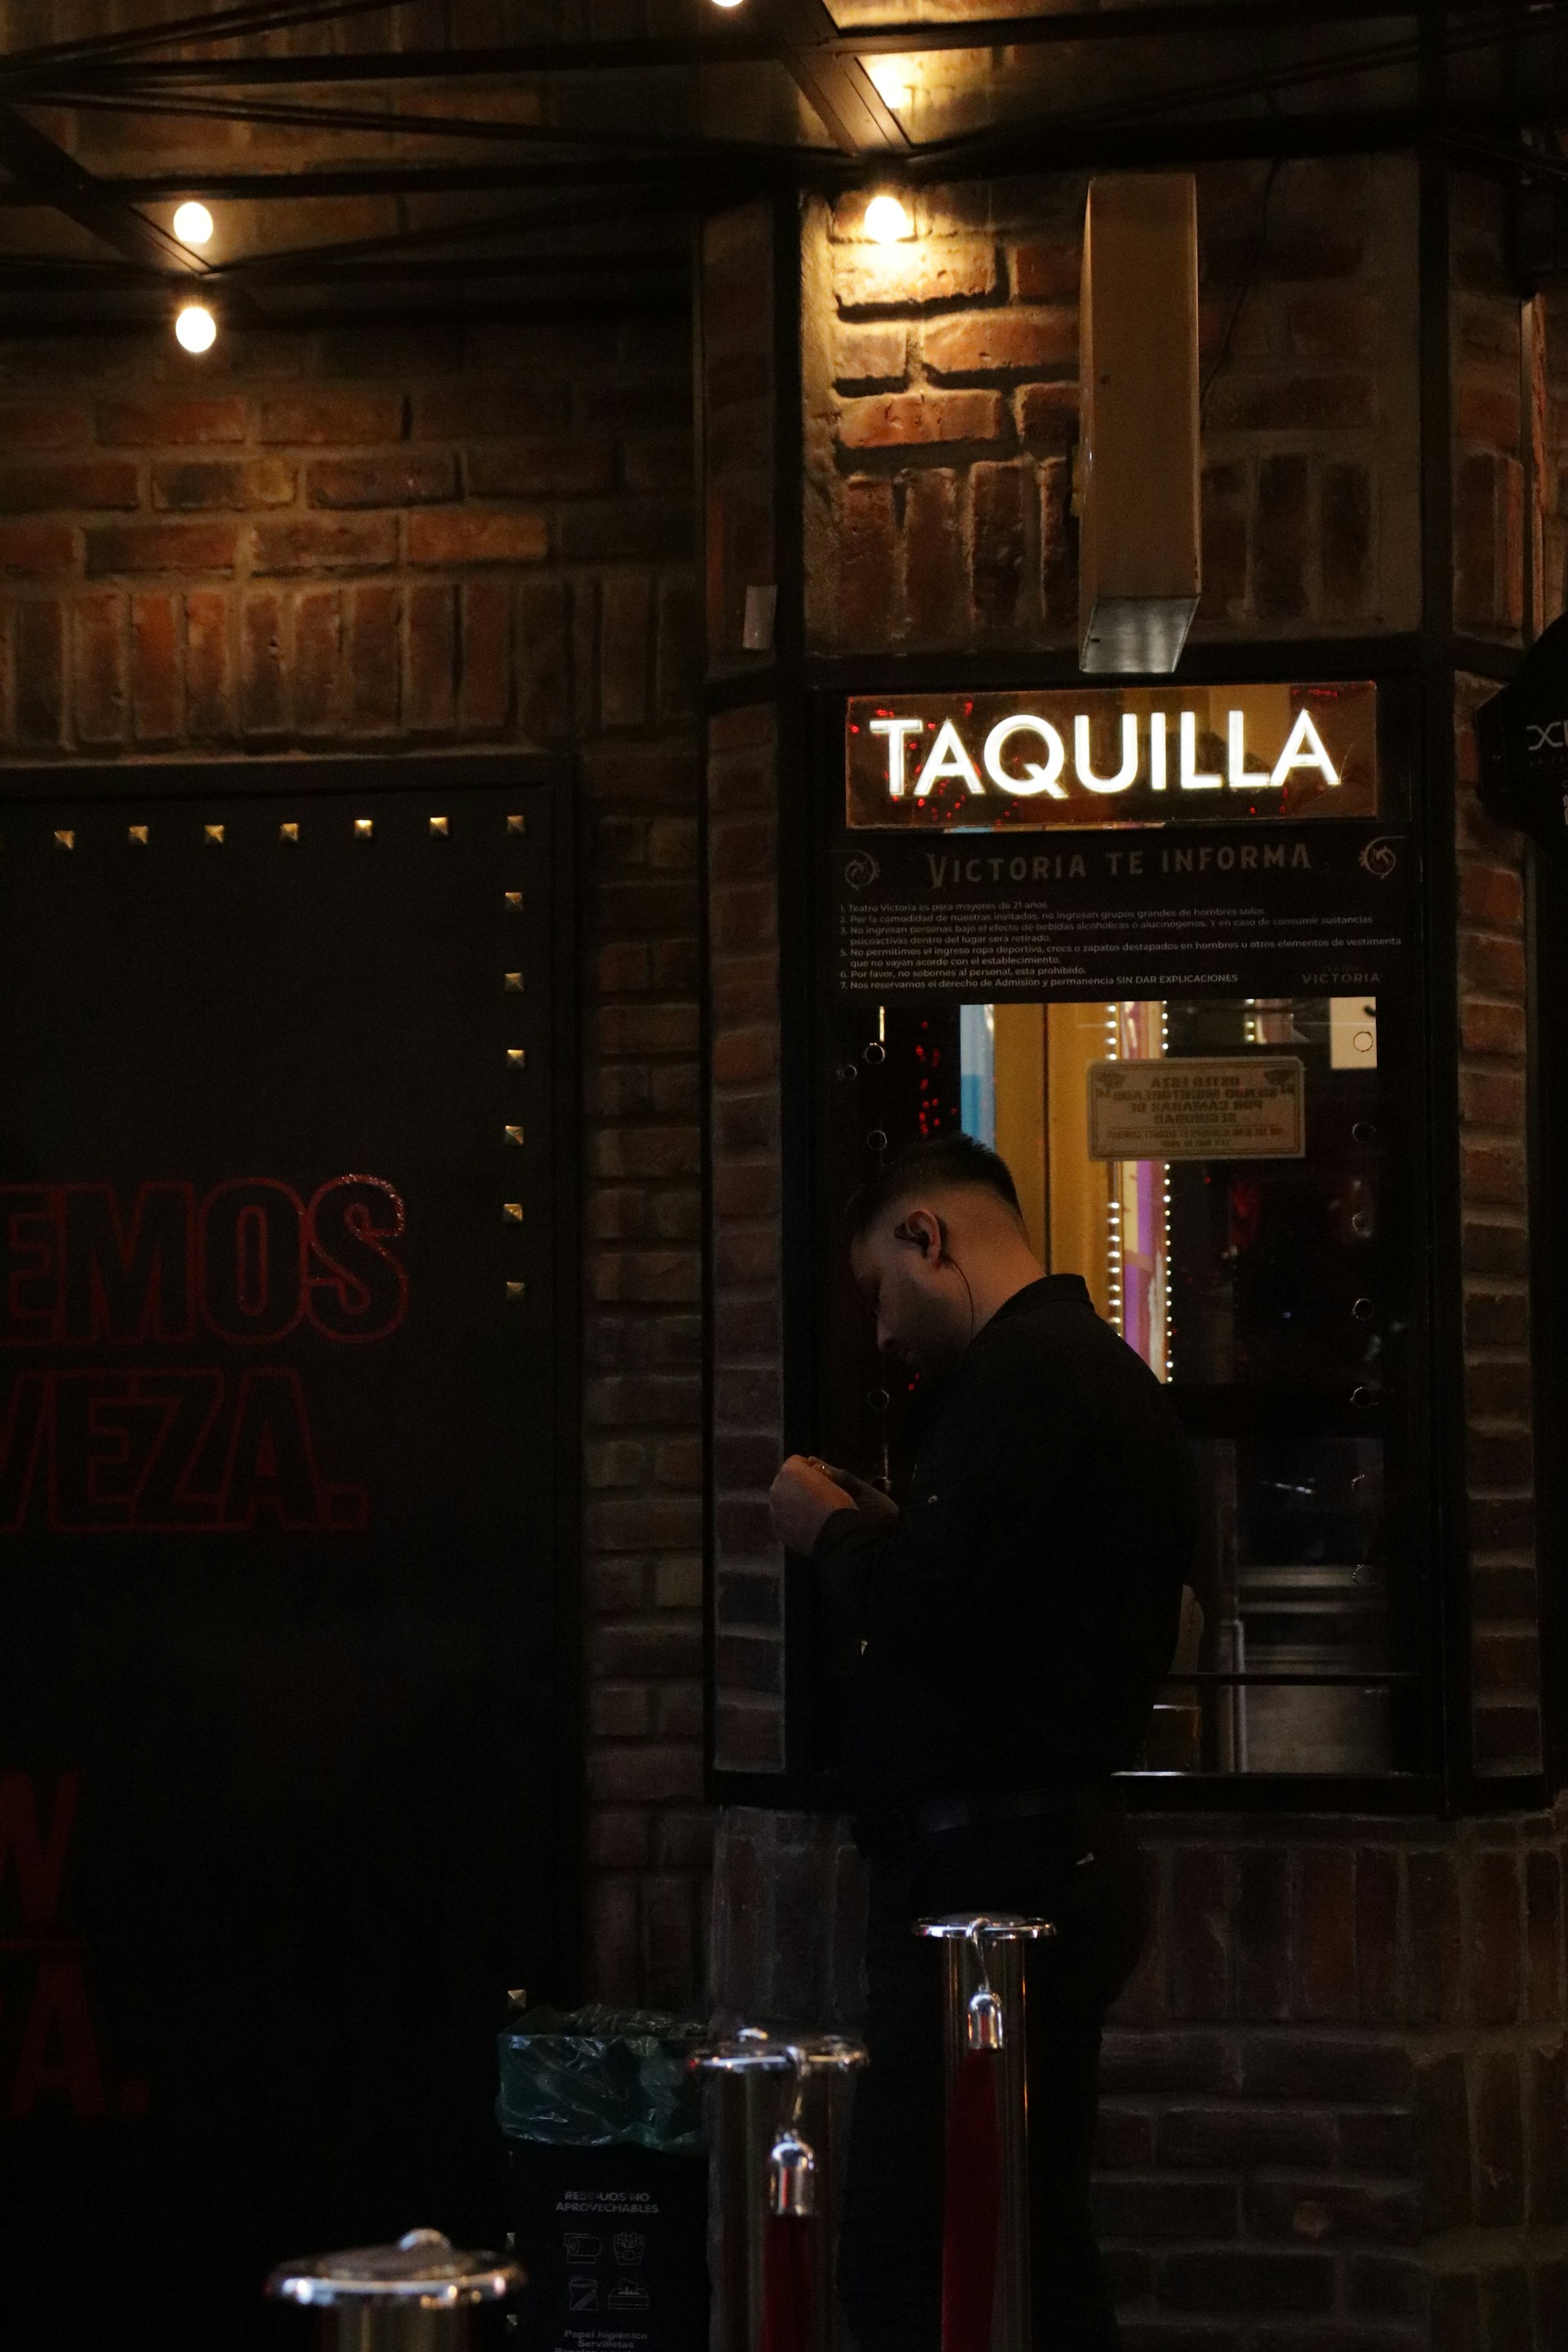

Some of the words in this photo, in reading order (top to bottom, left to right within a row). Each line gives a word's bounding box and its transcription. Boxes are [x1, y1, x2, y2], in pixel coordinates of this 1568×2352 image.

[869, 707, 1341, 799] TAQUILLA
[925, 852, 1086, 890] VICTORIA
[1105, 851, 1143, 876] TE
[1160, 843, 1312, 873] INFORMA
[849, 904, 879, 912] Teatro
[880, 903, 917, 912] Victoria
[932, 904, 954, 913] para
[956, 903, 996, 912] mayores
[1013, 901, 1022, 909] 21
[850, 915, 866, 924] Por
[869, 915, 878, 923] la
[880, 914, 933, 923] comodidad
[935, 914, 948, 922] de
[951, 914, 992, 922] nuestras
[1057, 911, 1098, 921] ingresan
[1101, 911, 1135, 920] grupos
[1137, 909, 1177, 920] grandes
[1178, 908, 1192, 916] de
[1194, 907, 1237, 916] hombres
[850, 926, 865, 934] No
[866, 925, 908, 936] ingresan
[910, 925, 954, 935] personas
[956, 924, 977, 934] bajo
[978, 924, 987, 932] el
[989, 924, 1019, 932] efecto
[1021, 924, 1034, 932] de
[1036, 922, 1075, 931] bebidas
[1258, 917, 1272, 925] de
[1272, 916, 1320, 925] consumir
[1321, 915, 1374, 924] sustancias
[850, 937, 909, 947] psicoactivas
[910, 936, 943, 945] dentro
[944, 935, 960, 943] del
[961, 935, 987, 945] lugar
[850, 948, 864, 956] No
[866, 947, 921, 958] permitimos
[923, 947, 932, 956] el
[934, 946, 970, 957] ingreso
[972, 947, 994, 956] ropa
[1046, 945, 1072, 953] crocs
[1083, 944, 1120, 953] zapatos
[1122, 942, 1178, 952] destapados
[1195, 940, 1240, 950] hombres
[1250, 940, 1275, 949] otros
[1276, 938, 1330, 948] elementos
[1331, 938, 1344, 947] de
[1346, 937, 1402, 947] vestimenta
[850, 960, 869, 969] que
[885, 959, 914, 969] vayan
[915, 957, 948, 967] acorde
[950, 958, 969, 966] con
[970, 956, 979, 965] el
[840, 970, 849, 979] 6.
[851, 969, 867, 978] Por
[898, 969, 911, 978] no
[912, 969, 957, 978] sobornes
[958, 968, 968, 977] al
[1302, 973, 1380, 985] VICTORIA
[840, 981, 849, 989] 7.
[850, 981, 868, 990] Nos
[870, 981, 926, 989] reservamos
[928, 979, 937, 988] el
[938, 978, 978, 989] derecho
[980, 978, 993, 987] de
[1042, 979, 1049, 988] y
[1050, 978, 1115, 987] permanencia
[1116, 975, 1134, 985] SIN
[1135, 975, 1158, 984] DAR
[1159, 973, 1239, 984] EXPLICACIONES
[555, 2202, 660, 2214] APROVECHABLES
[564, 2329, 596, 2340] Papel
[577, 2339, 635, 2349] Servilletas
